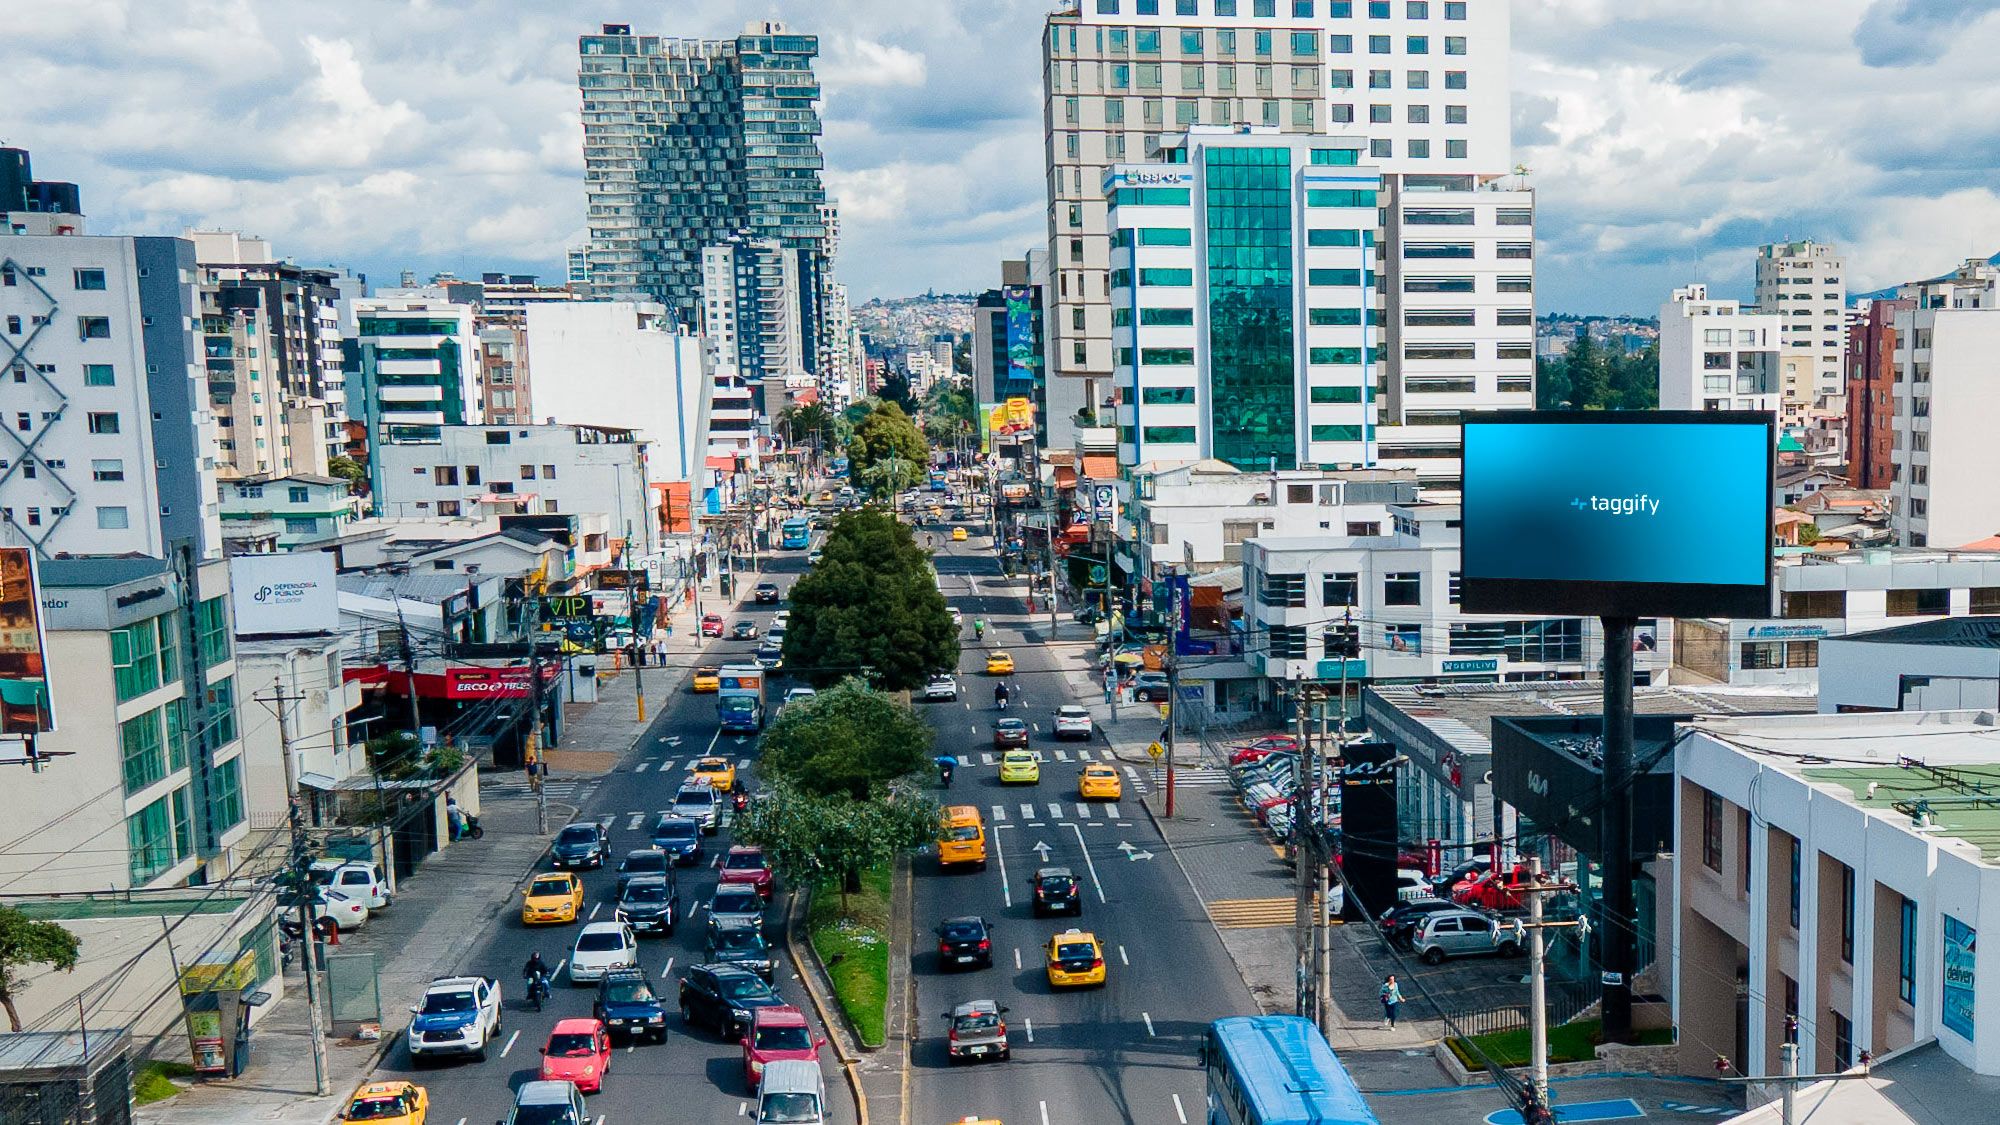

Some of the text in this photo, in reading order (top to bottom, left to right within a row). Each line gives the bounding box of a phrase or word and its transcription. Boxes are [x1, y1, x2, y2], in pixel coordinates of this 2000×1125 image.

[1590, 493, 1660, 516] taggify
[550, 597, 586, 617] VIP
[1453, 661, 1497, 670] DEPILIVE
[456, 683, 489, 692] ERCO
[1946, 963, 1976, 989] delivery
